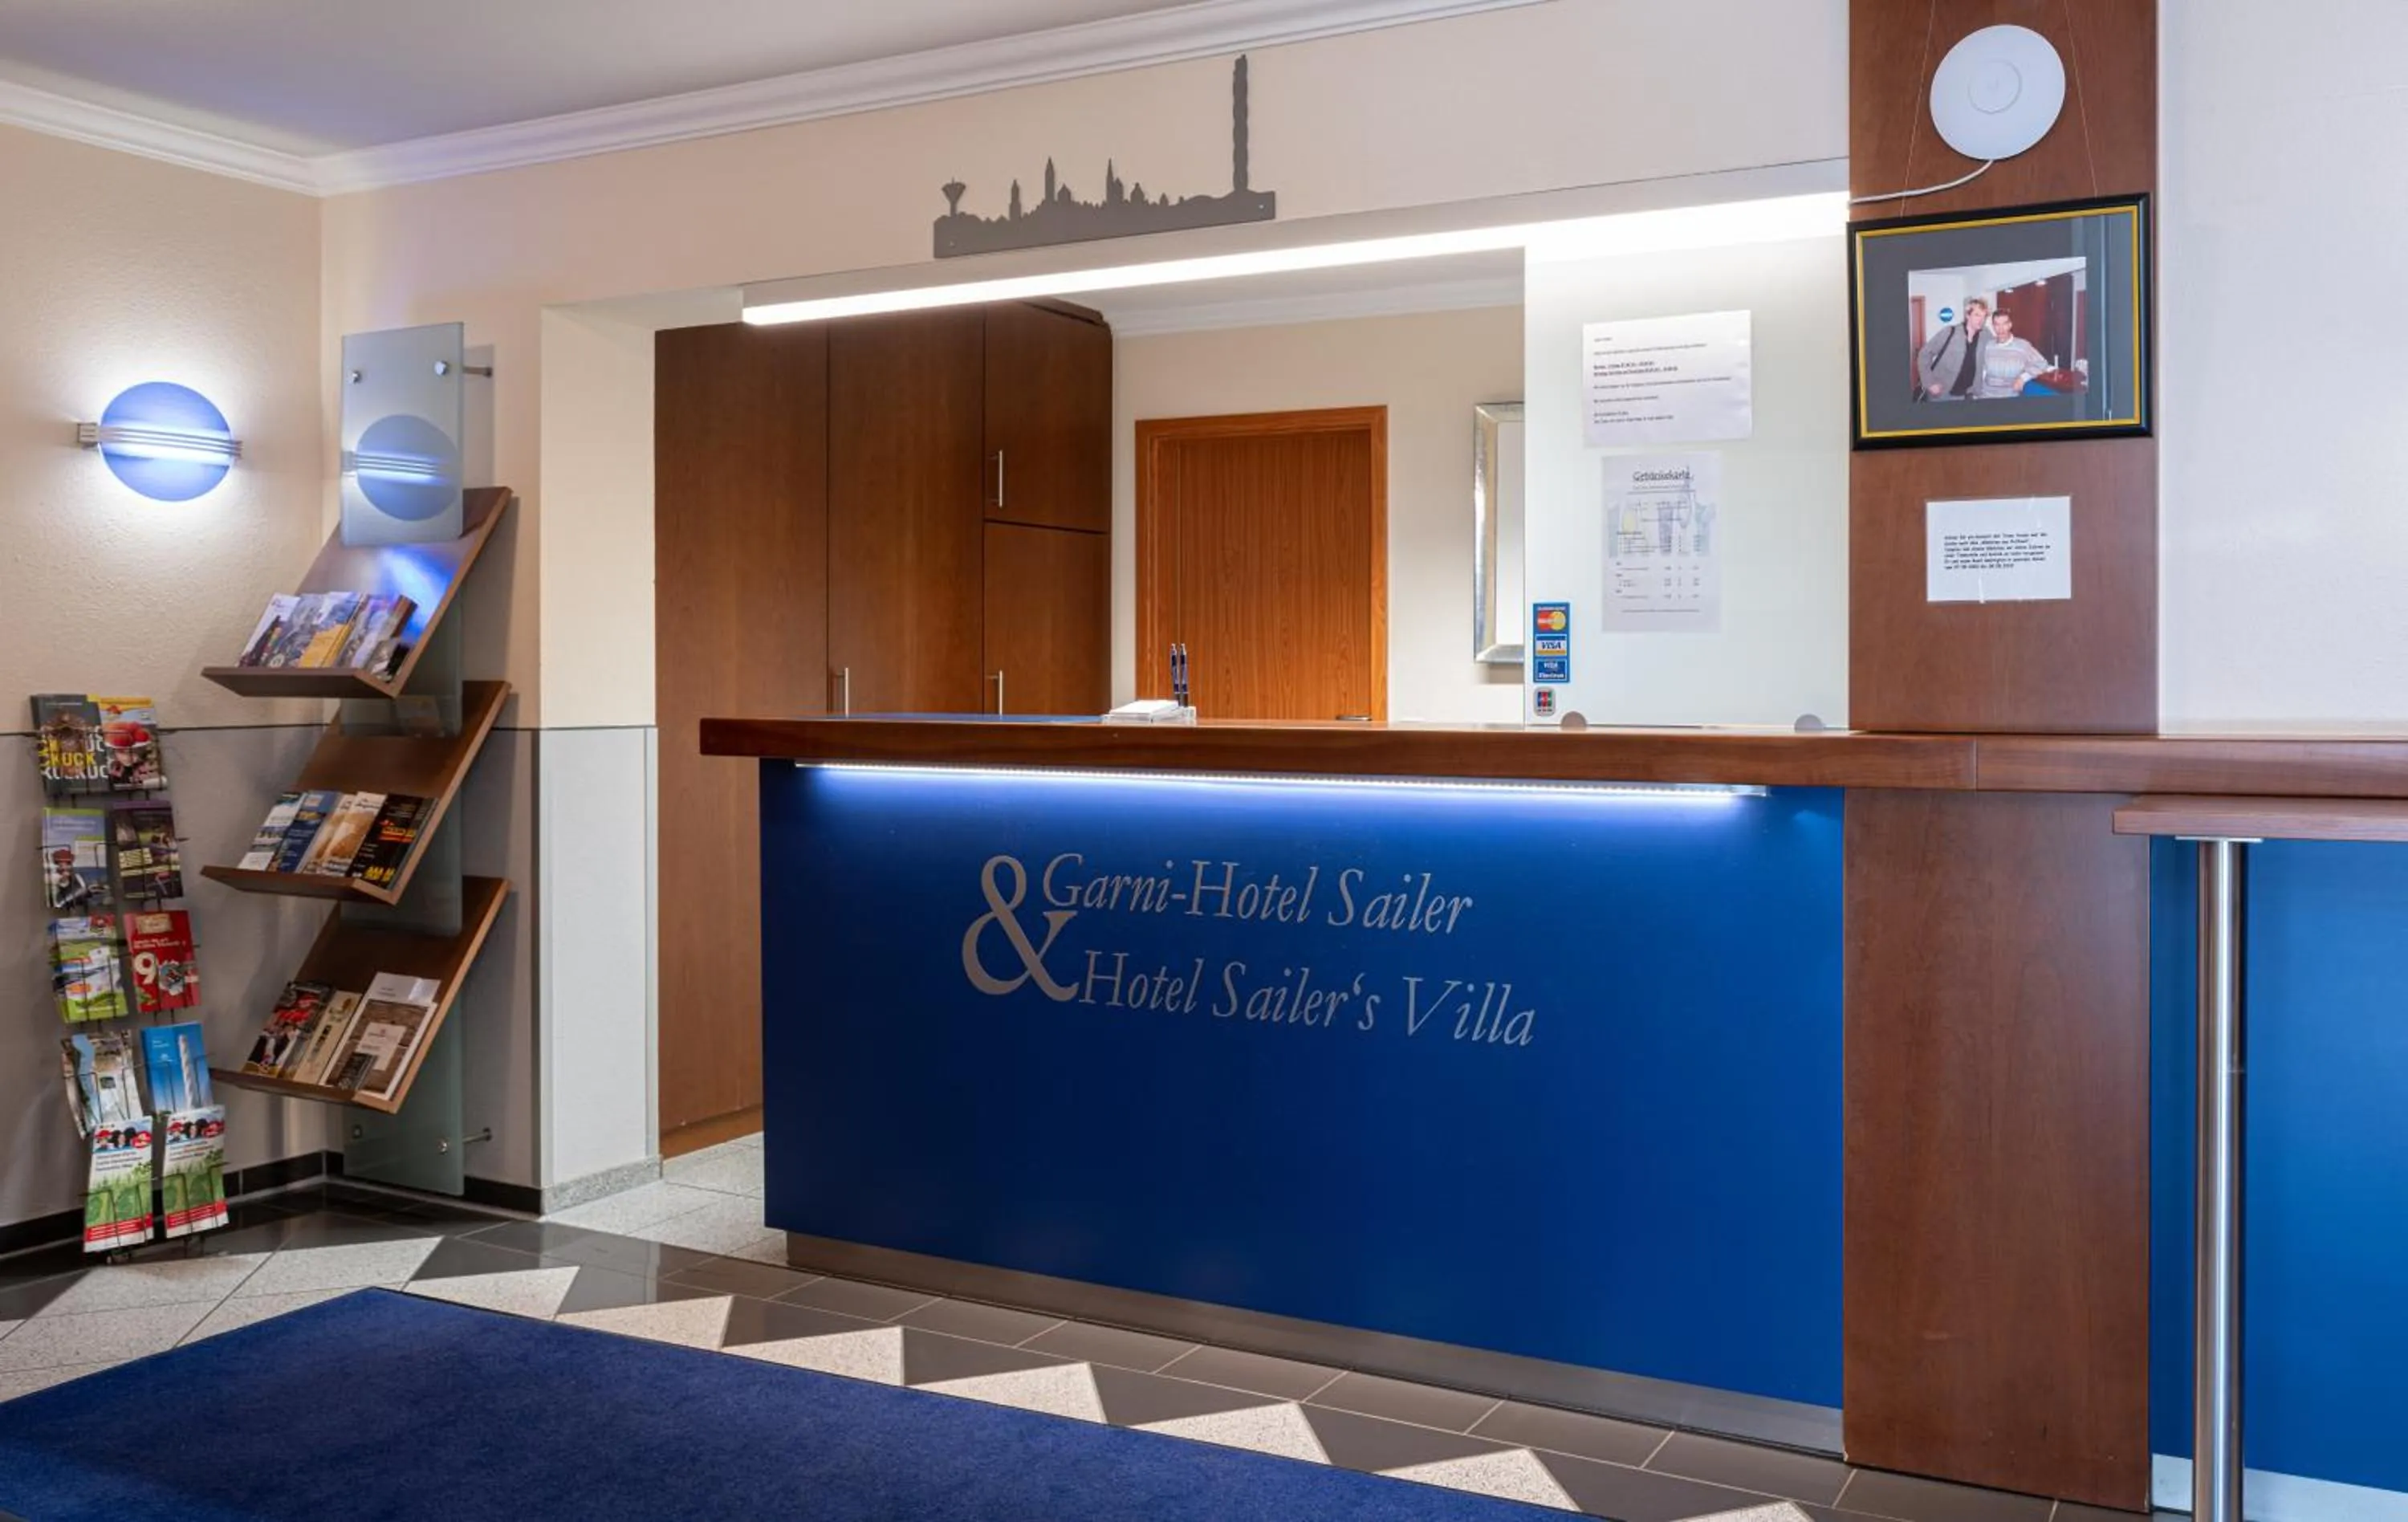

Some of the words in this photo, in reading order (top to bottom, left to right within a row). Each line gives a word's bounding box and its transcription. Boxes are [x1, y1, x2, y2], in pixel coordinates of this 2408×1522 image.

[1541, 641, 1561, 649] VISA
[962, 854, 1080, 1002] &
[1043, 853, 1319, 923] Garni-Hotel
[1328, 868, 1473, 934] Sailer
[1079, 950, 1204, 1014] Hotel
[1213, 961, 1381, 1031] Sailer's
[1403, 976, 1536, 1047] Villa
